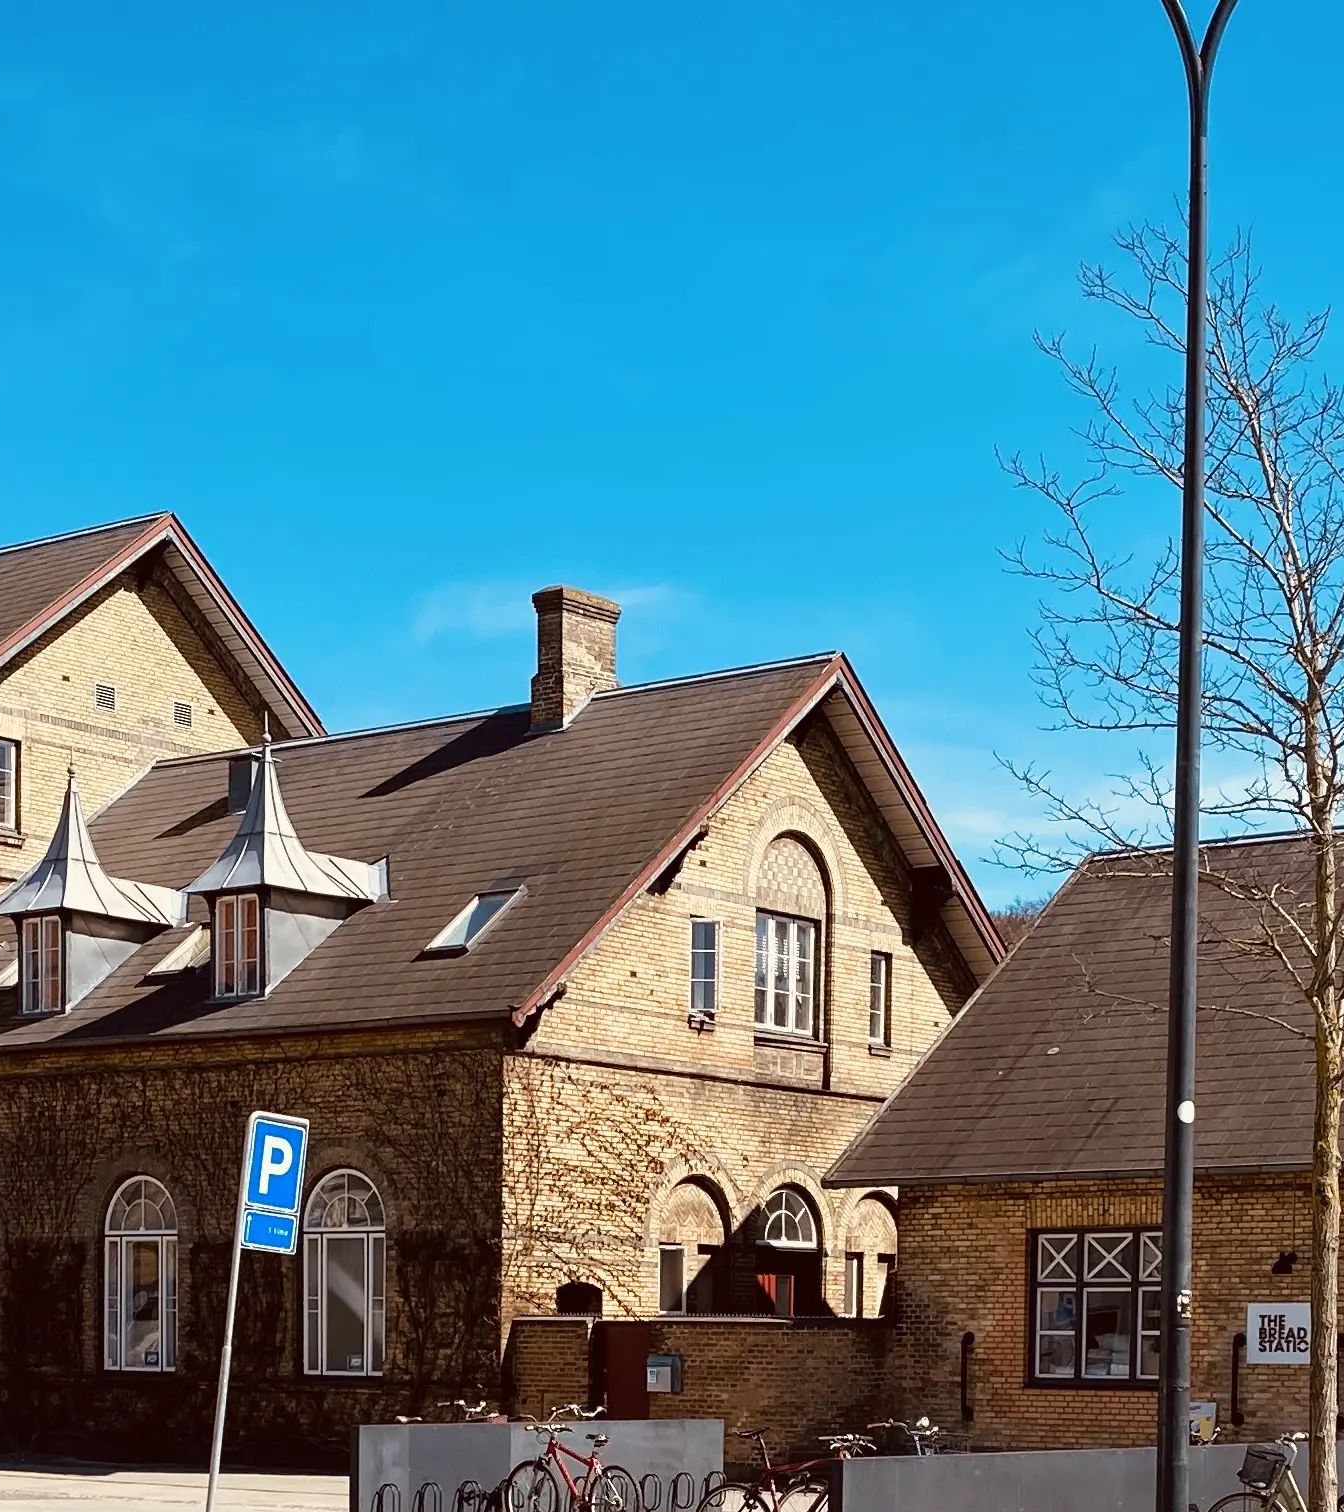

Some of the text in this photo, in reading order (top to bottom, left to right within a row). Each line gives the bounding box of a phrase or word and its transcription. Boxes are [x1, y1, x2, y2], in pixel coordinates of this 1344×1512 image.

[259, 1134, 293, 1195] P
[1258, 1315, 1286, 1328] THE
[1258, 1327, 1308, 1340] BREAD
[1258, 1339, 1309, 1353] STATIO
